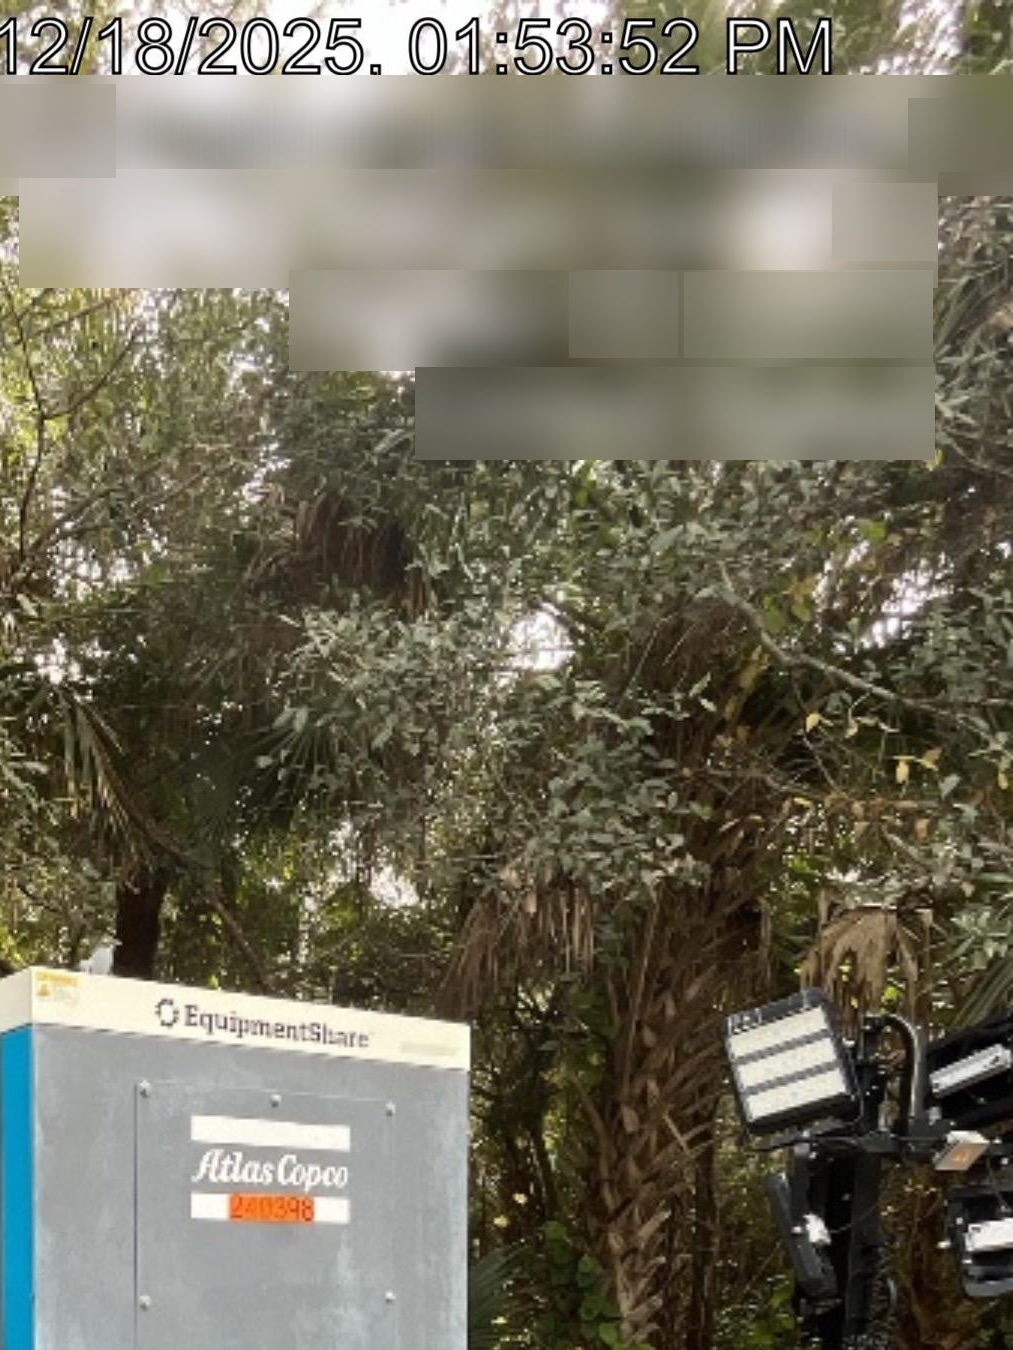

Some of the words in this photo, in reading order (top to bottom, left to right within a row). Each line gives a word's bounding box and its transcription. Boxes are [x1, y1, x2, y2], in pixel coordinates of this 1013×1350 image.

[184, 1005, 369, 1048] EquipmentShare
[192, 1148, 275, 1186] Atlas
[277, 1156, 349, 1192] Copco
